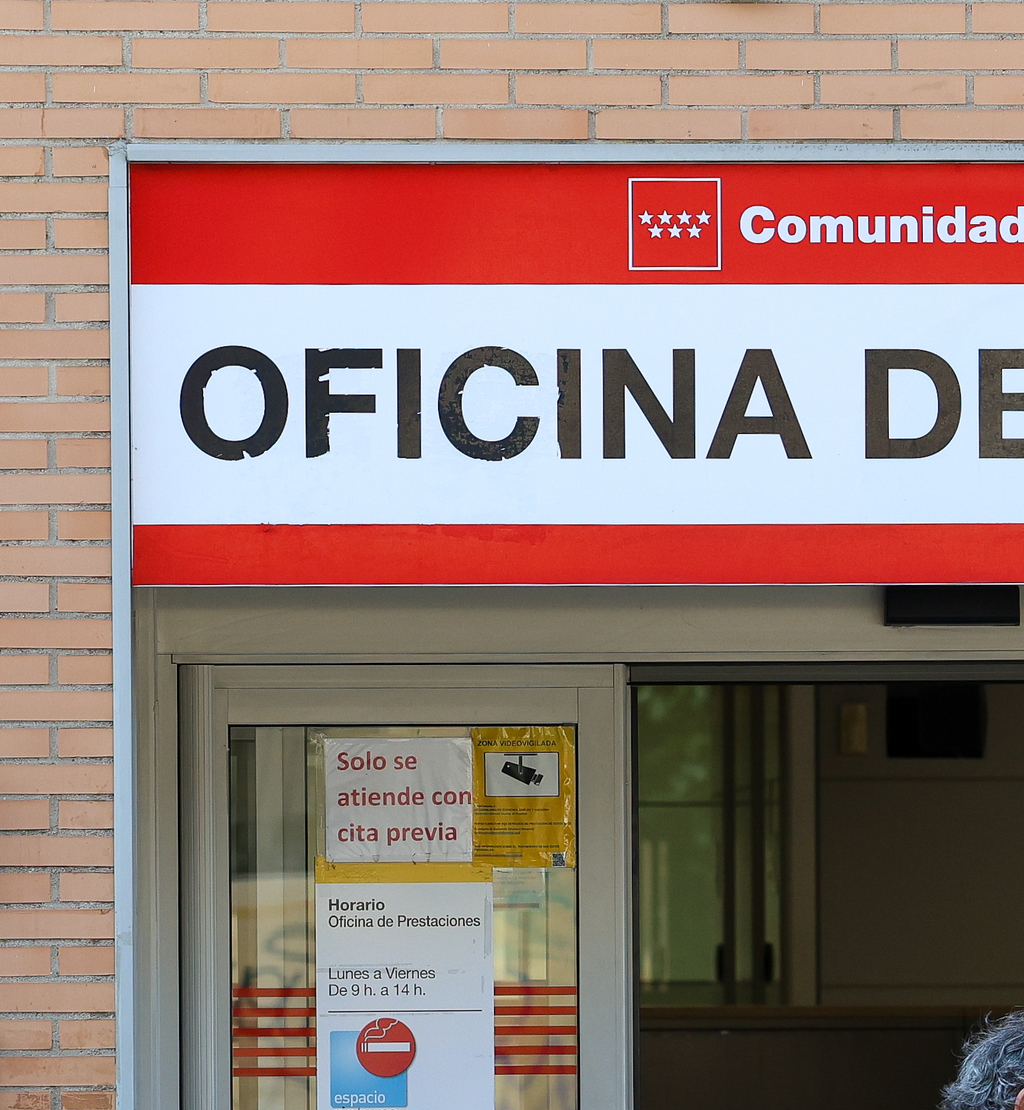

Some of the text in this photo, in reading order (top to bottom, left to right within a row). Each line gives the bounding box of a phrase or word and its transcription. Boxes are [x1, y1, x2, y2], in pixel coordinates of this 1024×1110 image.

[180, 346, 812, 461] OFICINA
[337, 751, 417, 771] Solo se
[337, 787, 472, 806] atiende con
[337, 822, 457, 846] cita previa
[328, 899, 385, 911] Horario
[328, 914, 481, 928] Oficina de Prestaciones
[328, 967, 436, 980] Lunes a Viernes
[328, 983, 426, 996] De 9 h. a 14 h.
[334, 1090, 386, 1107] espacio
